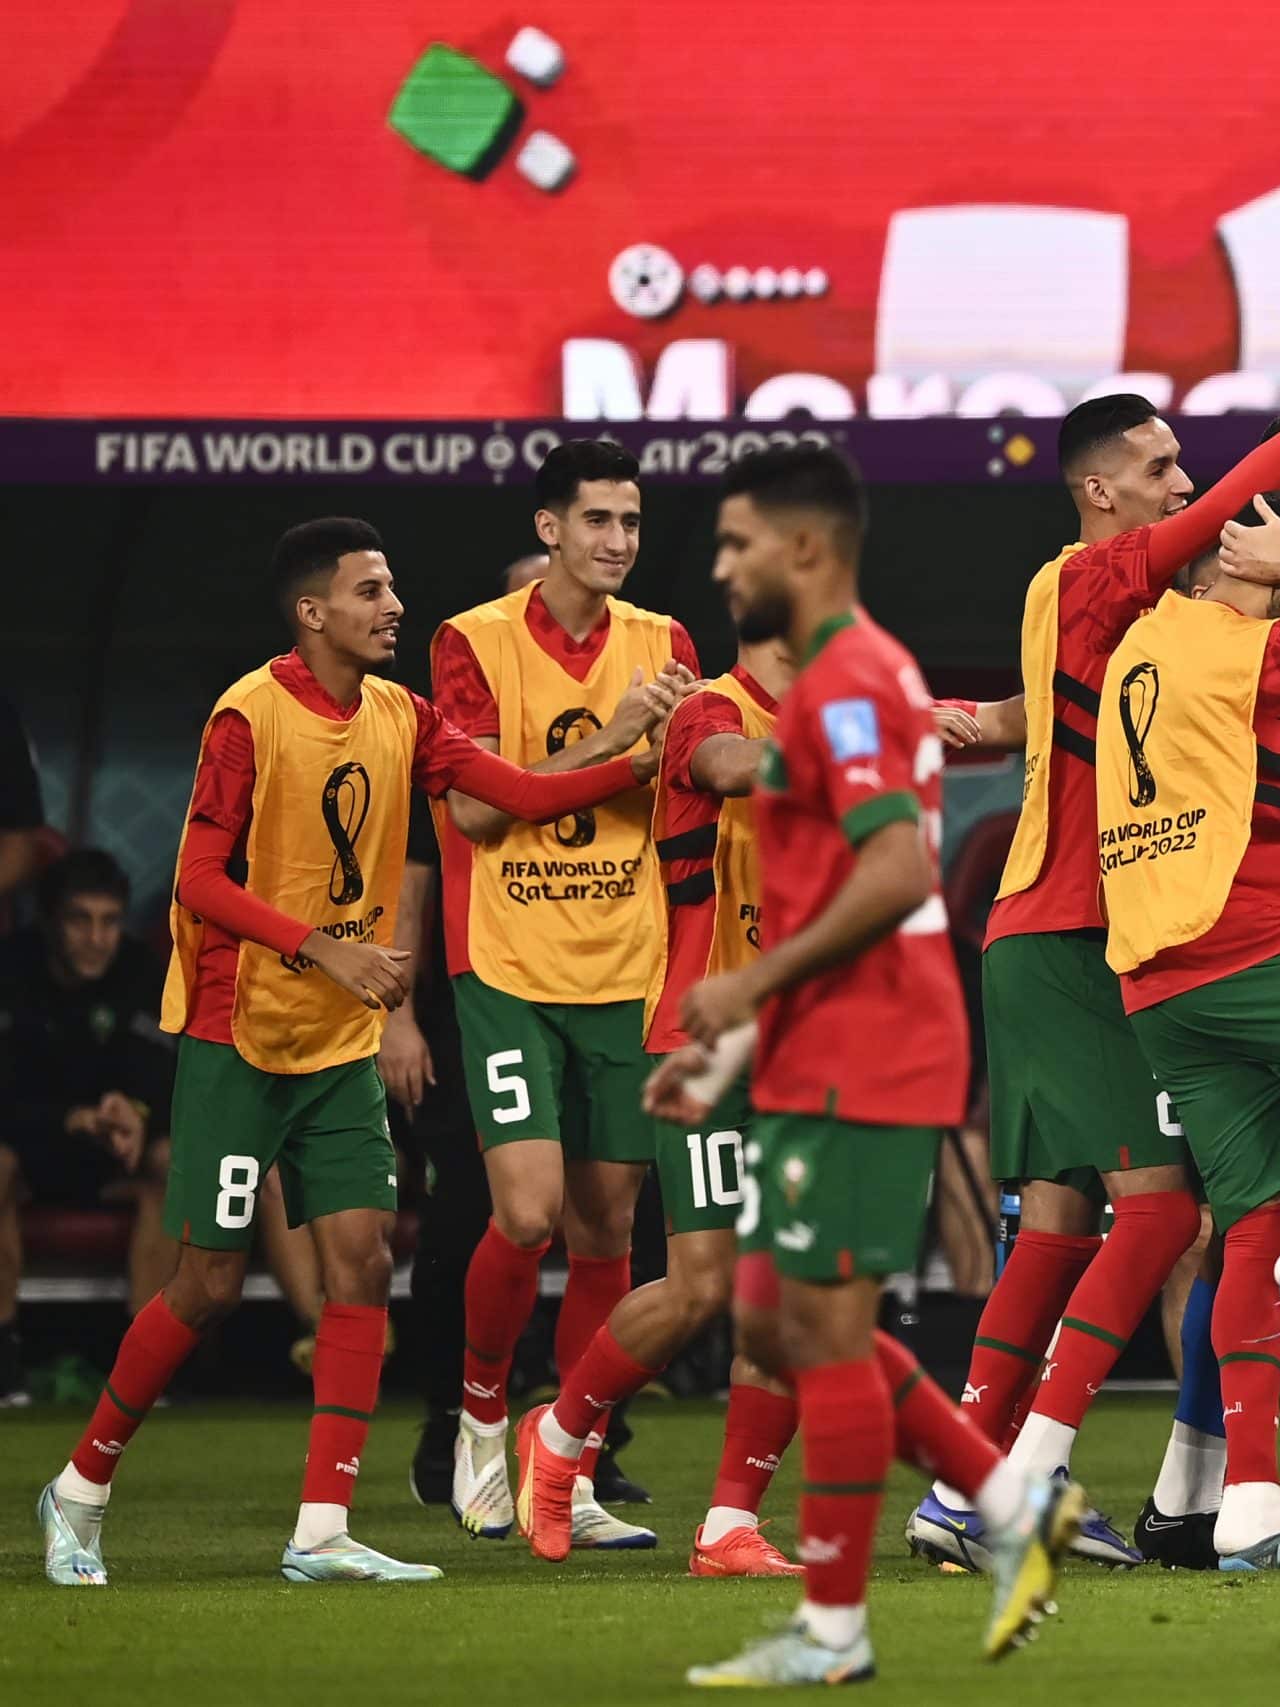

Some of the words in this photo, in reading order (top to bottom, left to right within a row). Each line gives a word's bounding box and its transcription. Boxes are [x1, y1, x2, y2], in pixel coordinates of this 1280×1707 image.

[97, 433, 197, 472] FIFA
[203, 433, 375, 472] WORLD
[384, 433, 474, 473] CUP
[1177, 809, 1206, 829] CUP
[502, 861, 541, 877] FIFA
[544, 860, 616, 877] WORLD
[486, 1049, 531, 1124] 5
[216, 1155, 259, 1229] 8
[687, 1130, 745, 1208] 10
